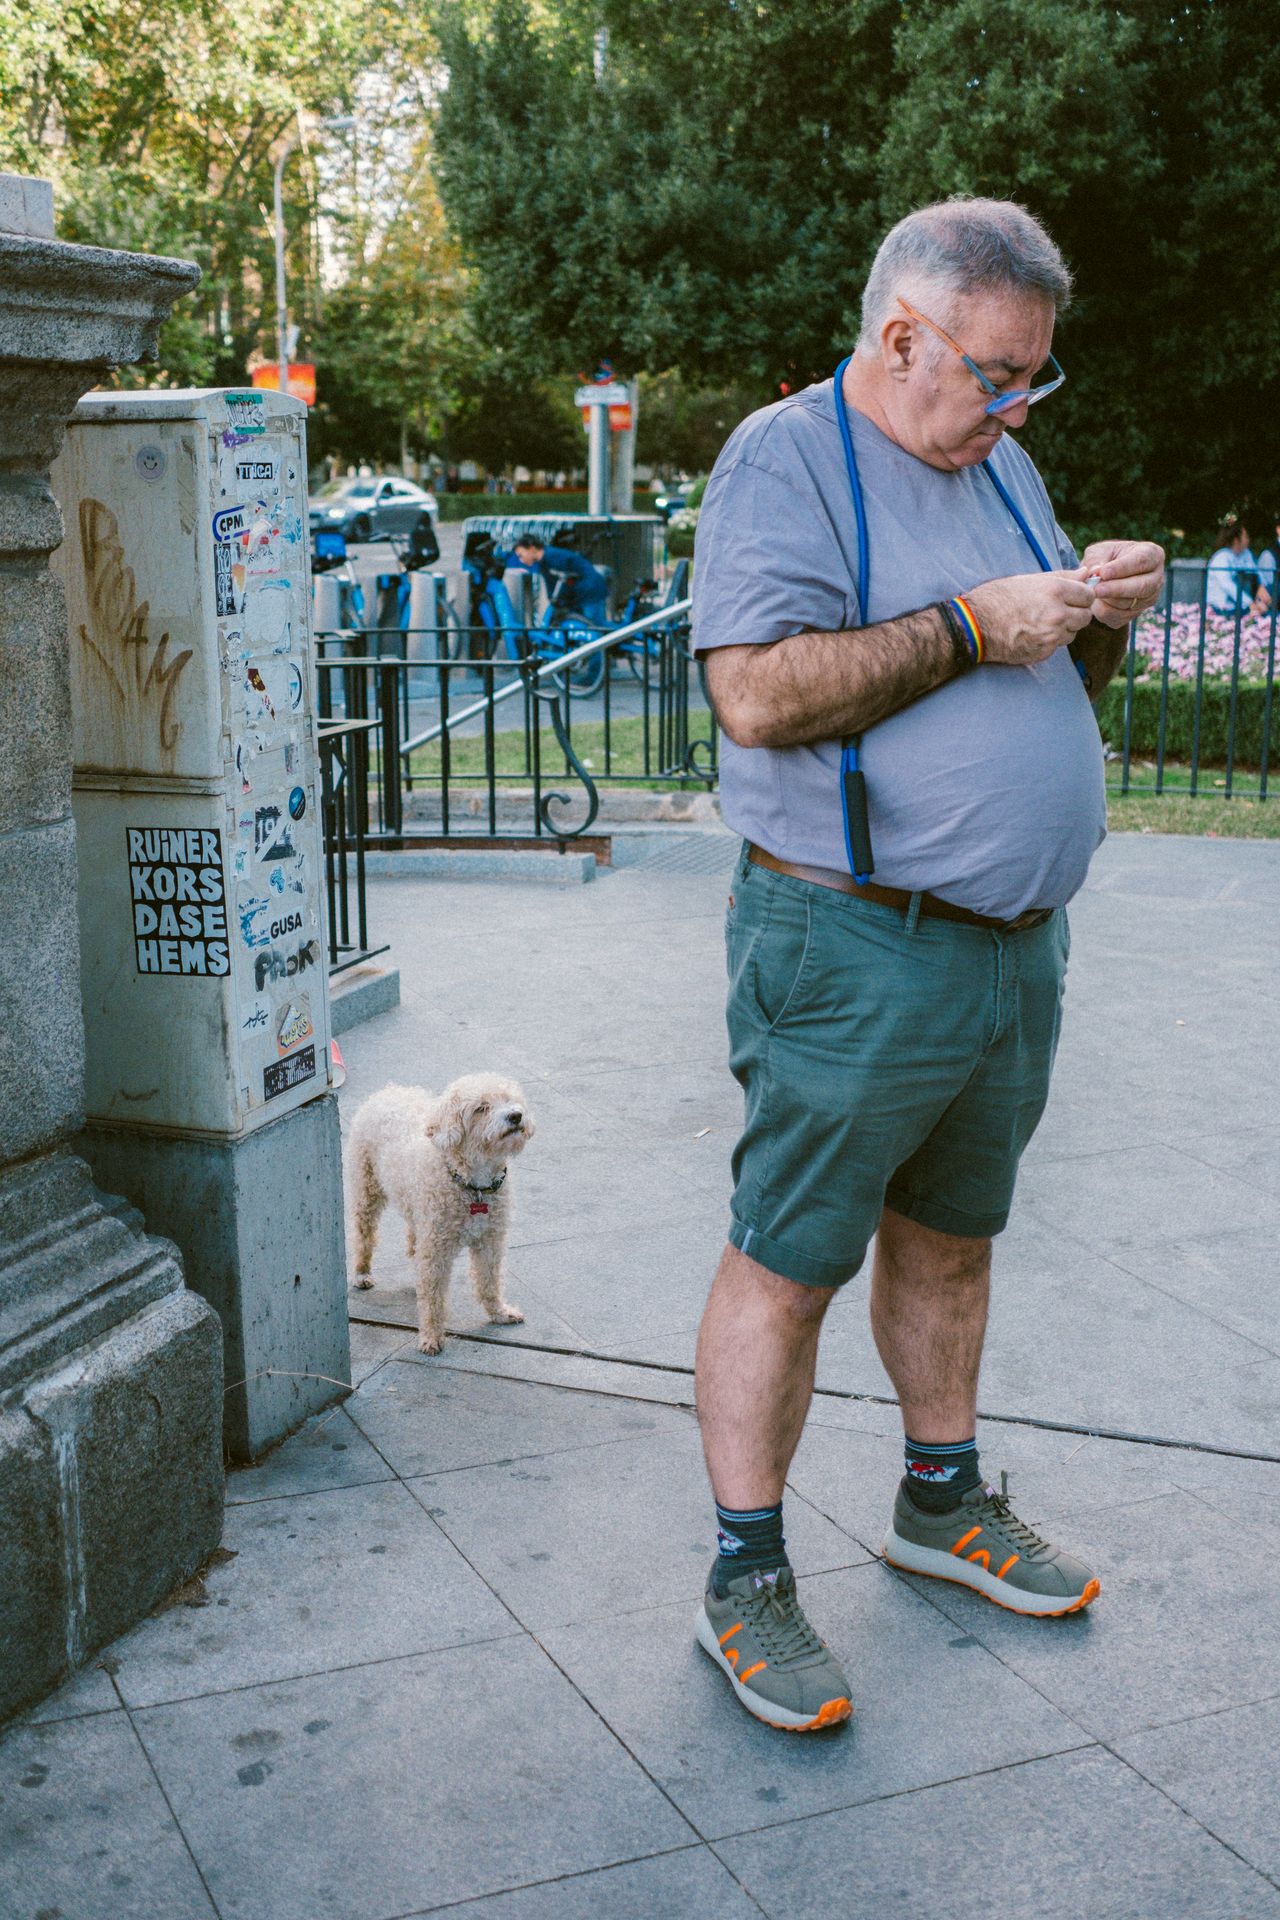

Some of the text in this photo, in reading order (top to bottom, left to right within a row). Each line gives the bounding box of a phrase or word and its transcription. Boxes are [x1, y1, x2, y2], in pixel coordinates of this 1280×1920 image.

[220, 514, 244, 532] CPM
[131, 866, 222, 902] KORS
[134, 903, 227, 938] DASE
[270, 912, 302, 939] GUSA
[137, 939, 229, 975] HEMS
